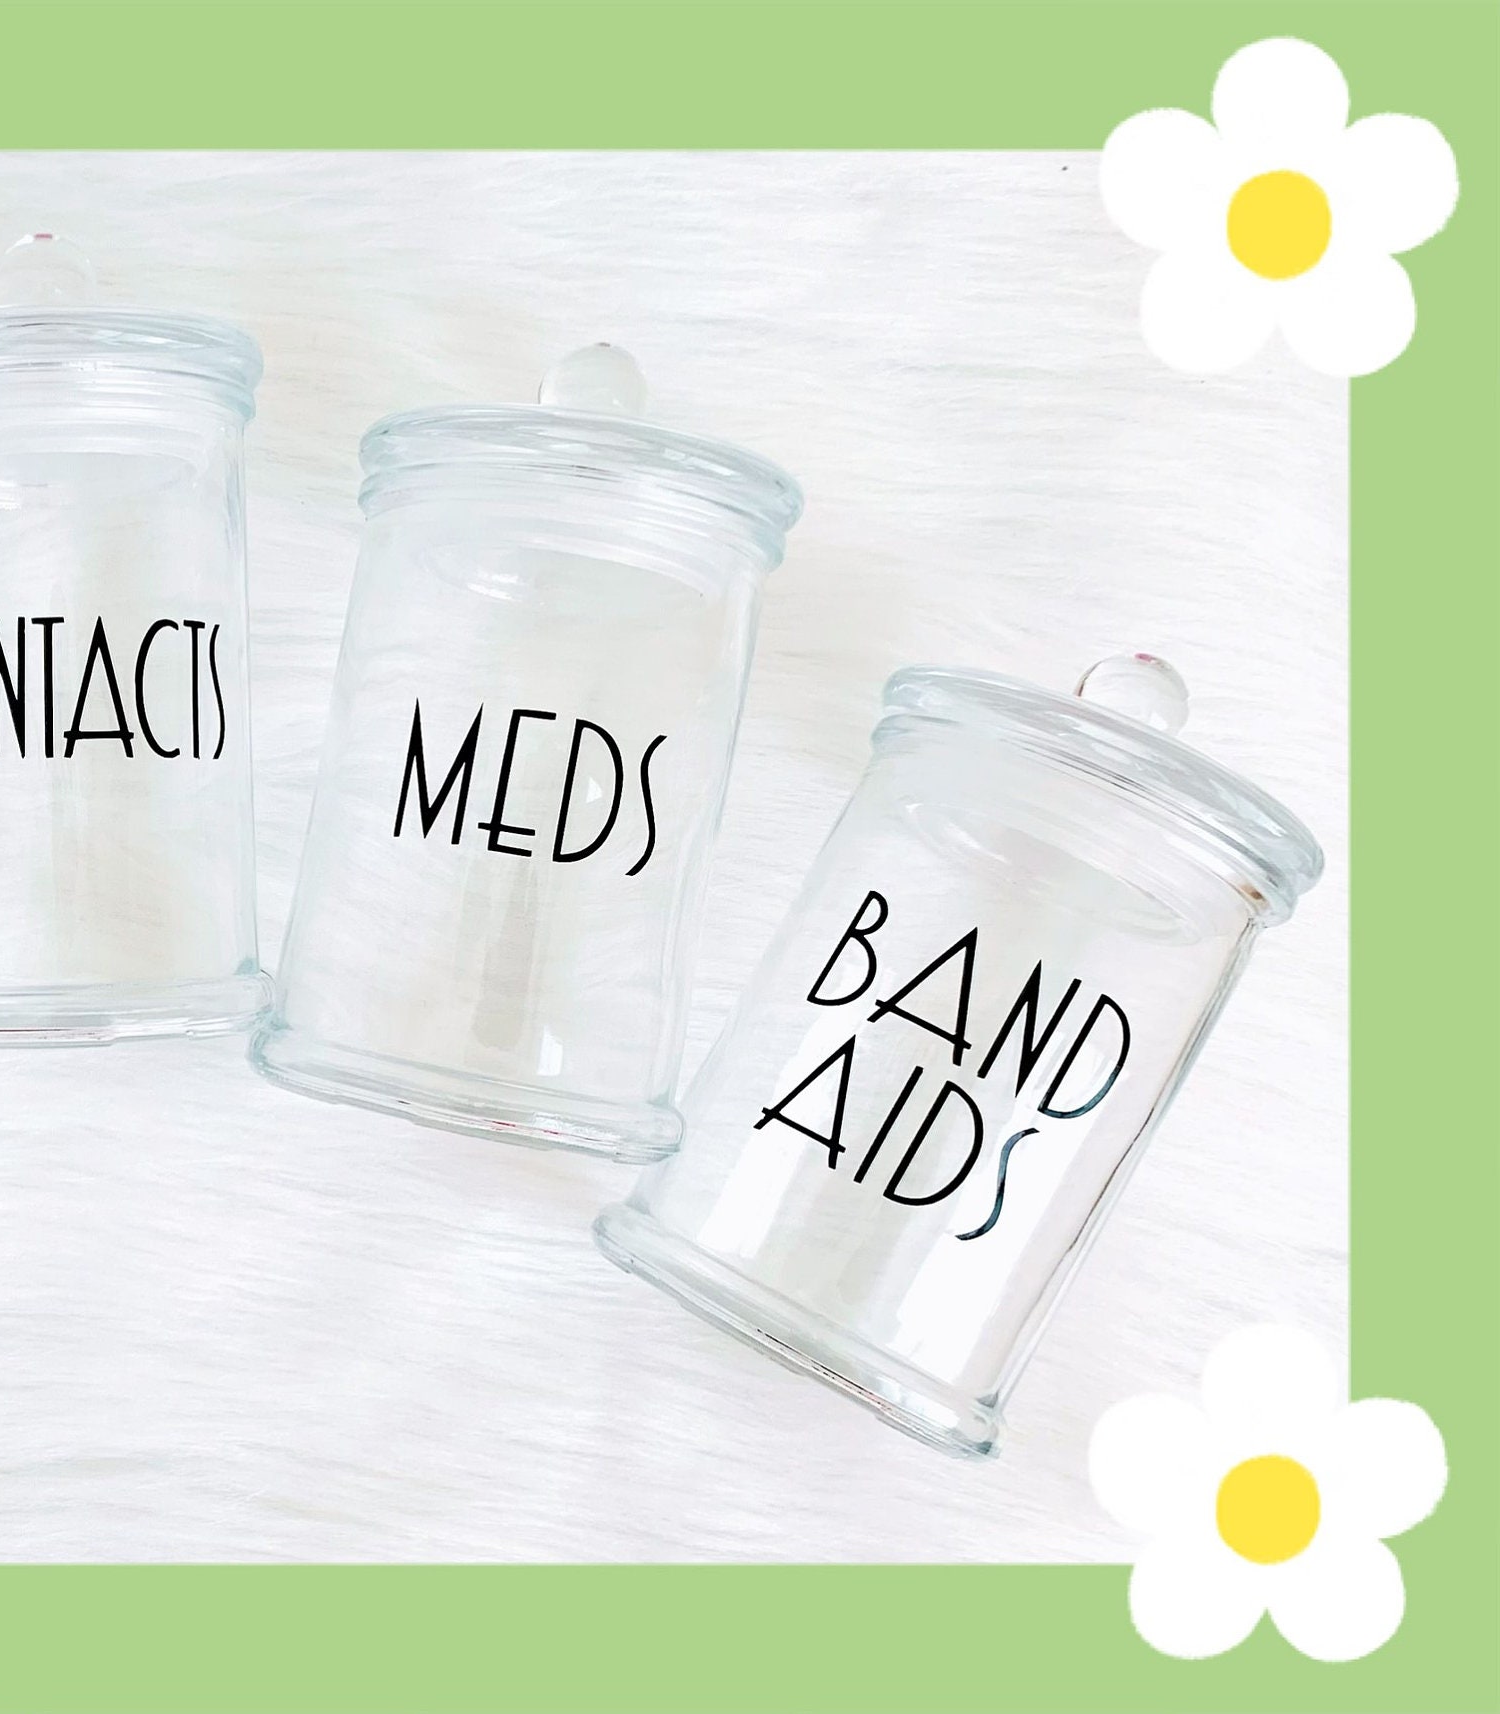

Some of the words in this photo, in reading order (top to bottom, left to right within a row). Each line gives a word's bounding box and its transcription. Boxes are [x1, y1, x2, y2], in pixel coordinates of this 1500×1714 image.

[393, 698, 668, 877] MEDS
[806, 890, 1132, 1120] BAND
[753, 1034, 1040, 1241] AIDS
